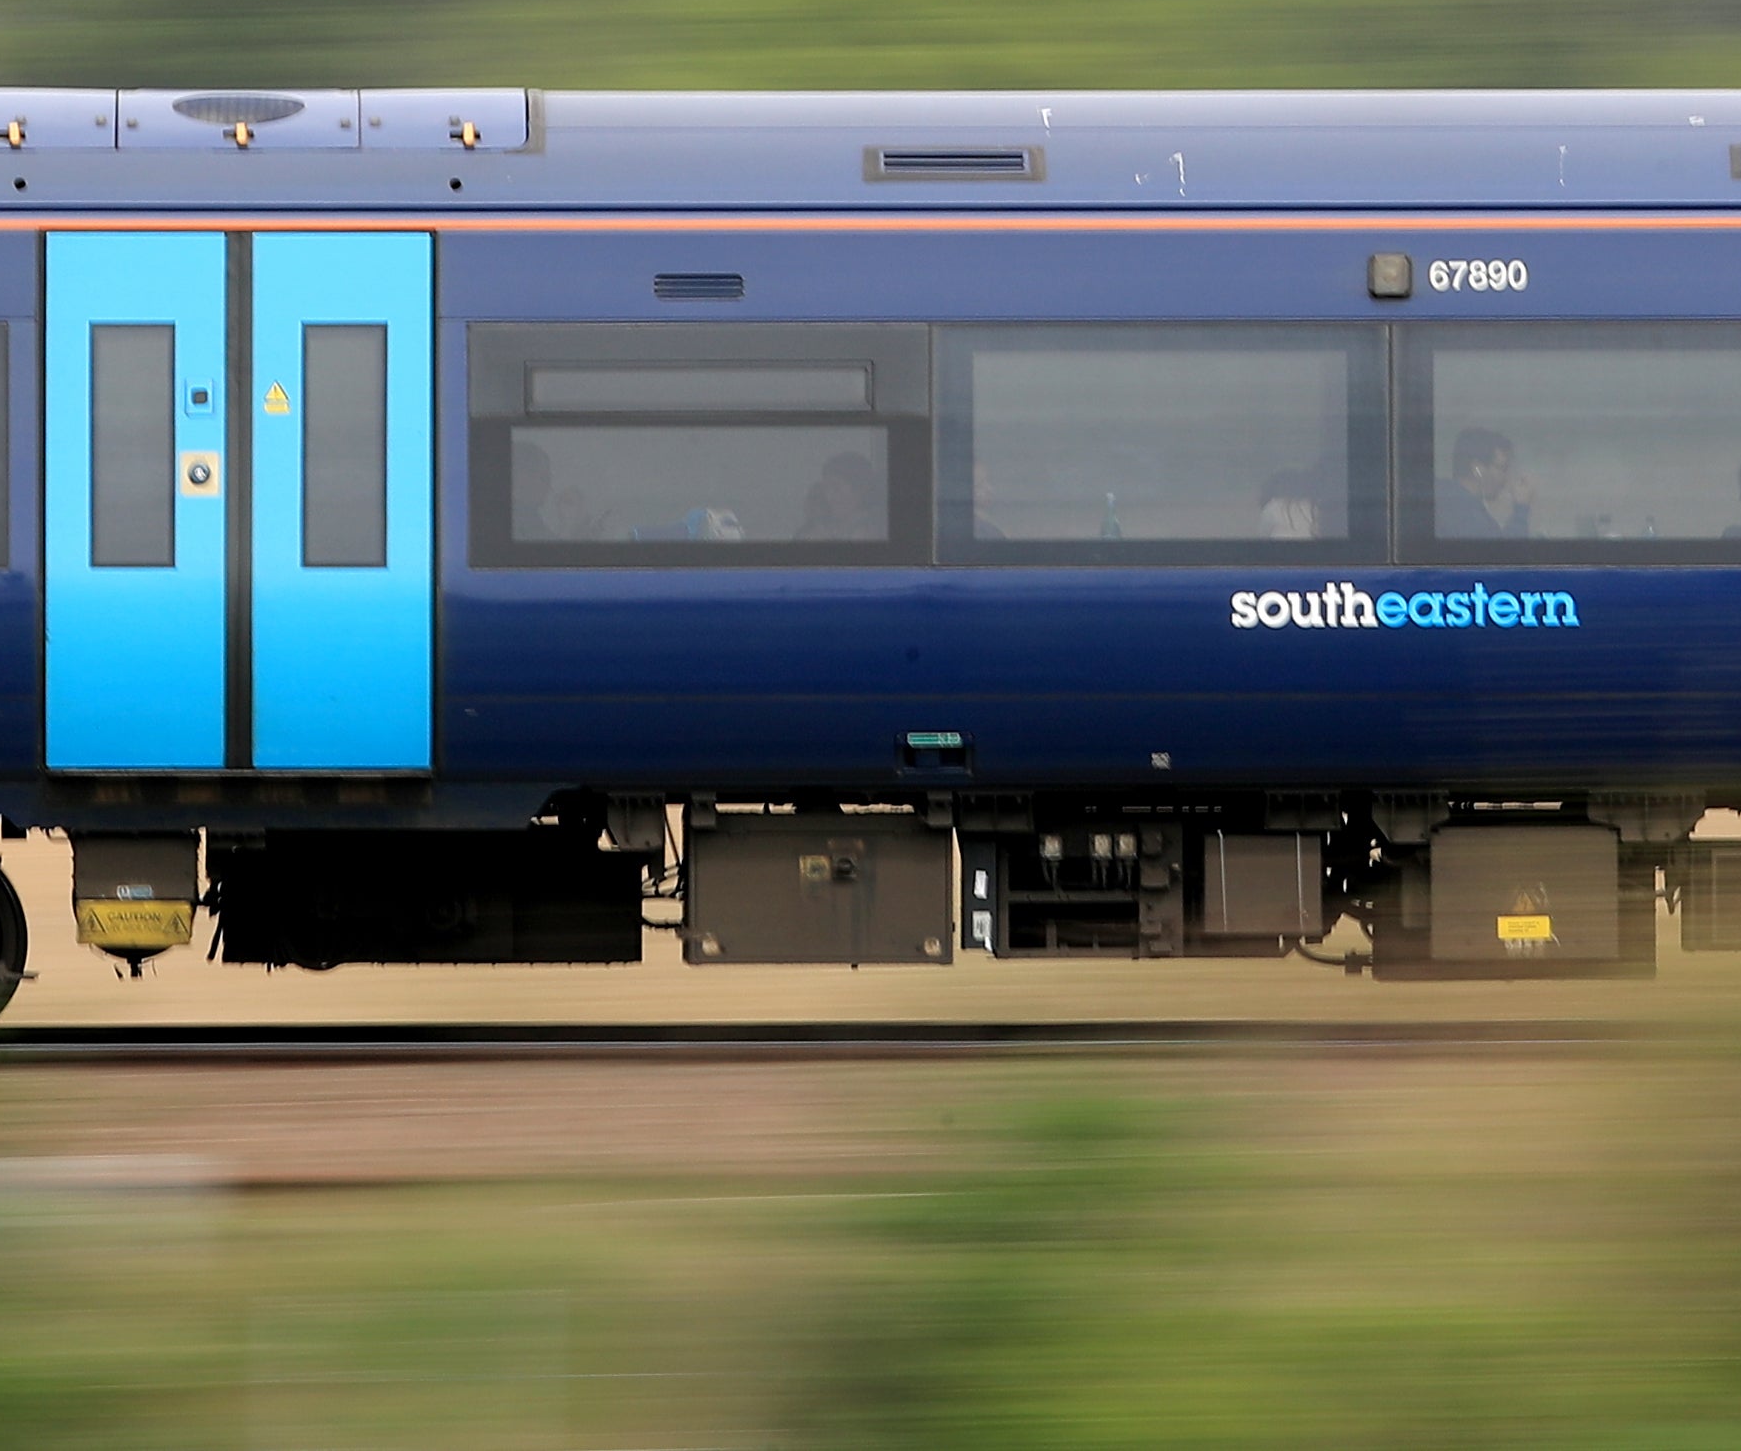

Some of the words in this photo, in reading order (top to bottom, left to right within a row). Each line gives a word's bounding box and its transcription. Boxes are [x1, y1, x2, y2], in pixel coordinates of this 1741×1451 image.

[1428, 259, 1529, 292] 67890
[1230, 581, 1581, 630] southeastern
[107, 910, 163, 922] CAUTION
